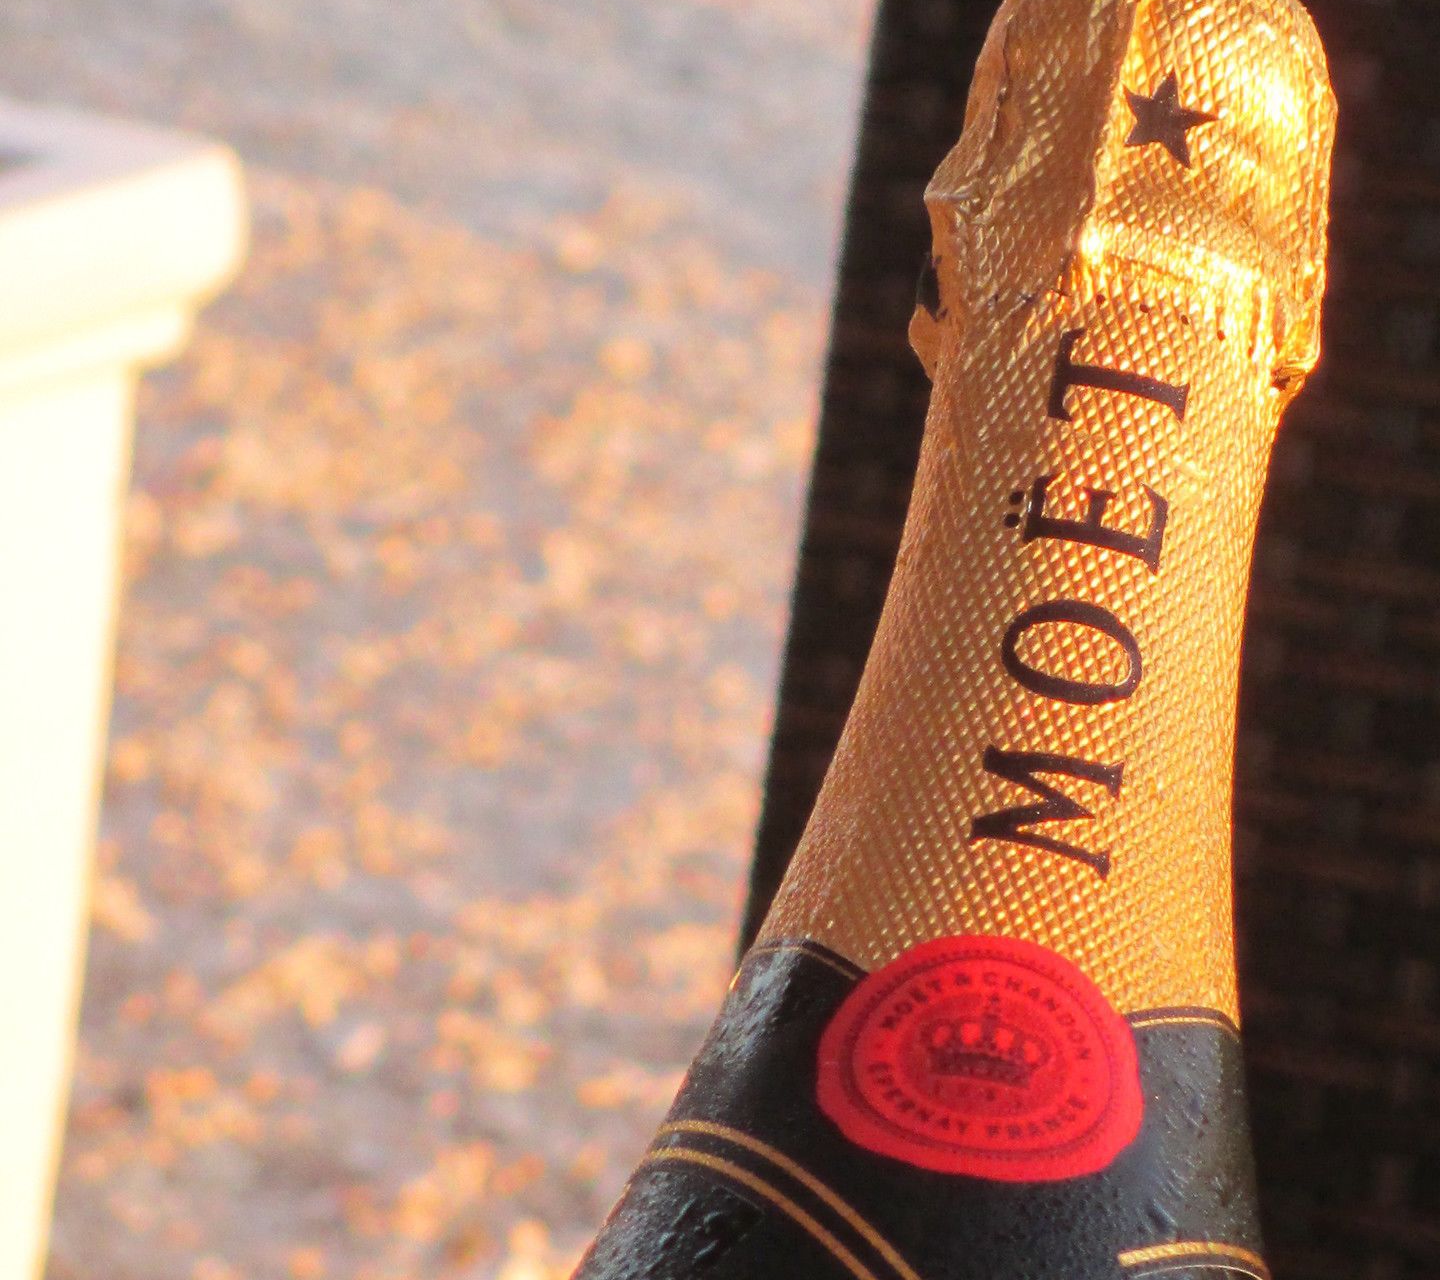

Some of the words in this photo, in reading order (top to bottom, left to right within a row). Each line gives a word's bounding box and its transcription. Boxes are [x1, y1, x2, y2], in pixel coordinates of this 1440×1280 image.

[968, 328, 1191, 880] MOËT
[983, 971, 1091, 1060] CHANDON
[986, 1097, 1088, 1139] FRANCE
